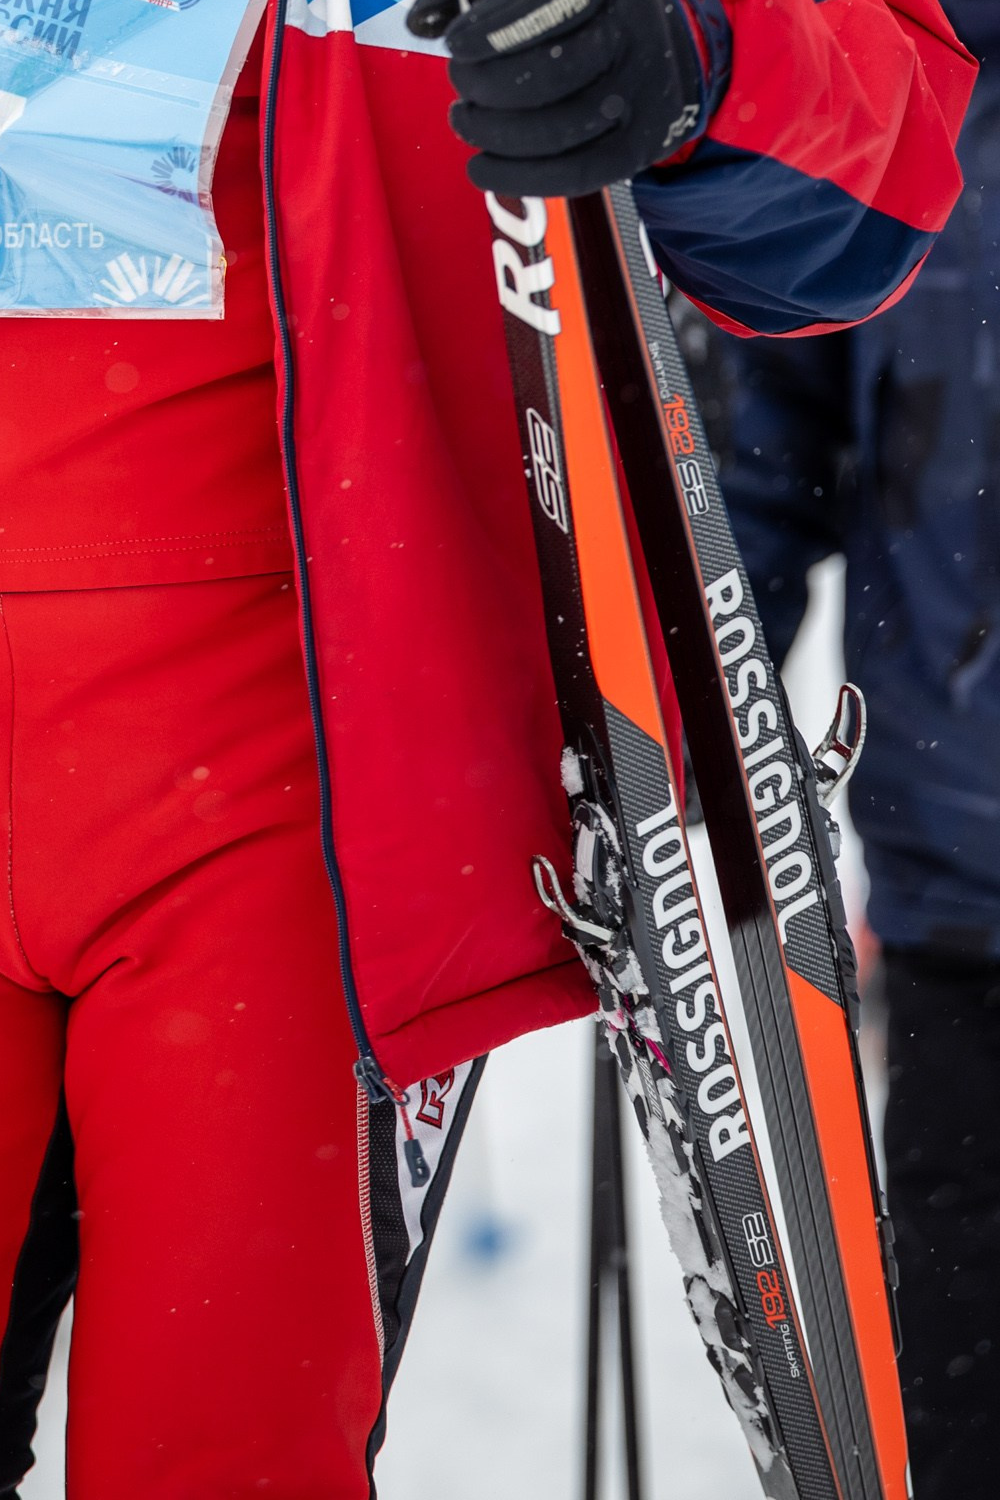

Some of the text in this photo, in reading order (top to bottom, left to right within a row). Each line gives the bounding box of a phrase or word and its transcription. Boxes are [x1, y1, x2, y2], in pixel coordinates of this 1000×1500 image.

[663, 393, 695, 455] 192
[676, 459, 709, 517] S2
[704, 567, 819, 946] ROSSIGNOL
[636, 783, 753, 1162] ROSSIGNOL
[742, 1211, 801, 1378] SKATING 192 S2
